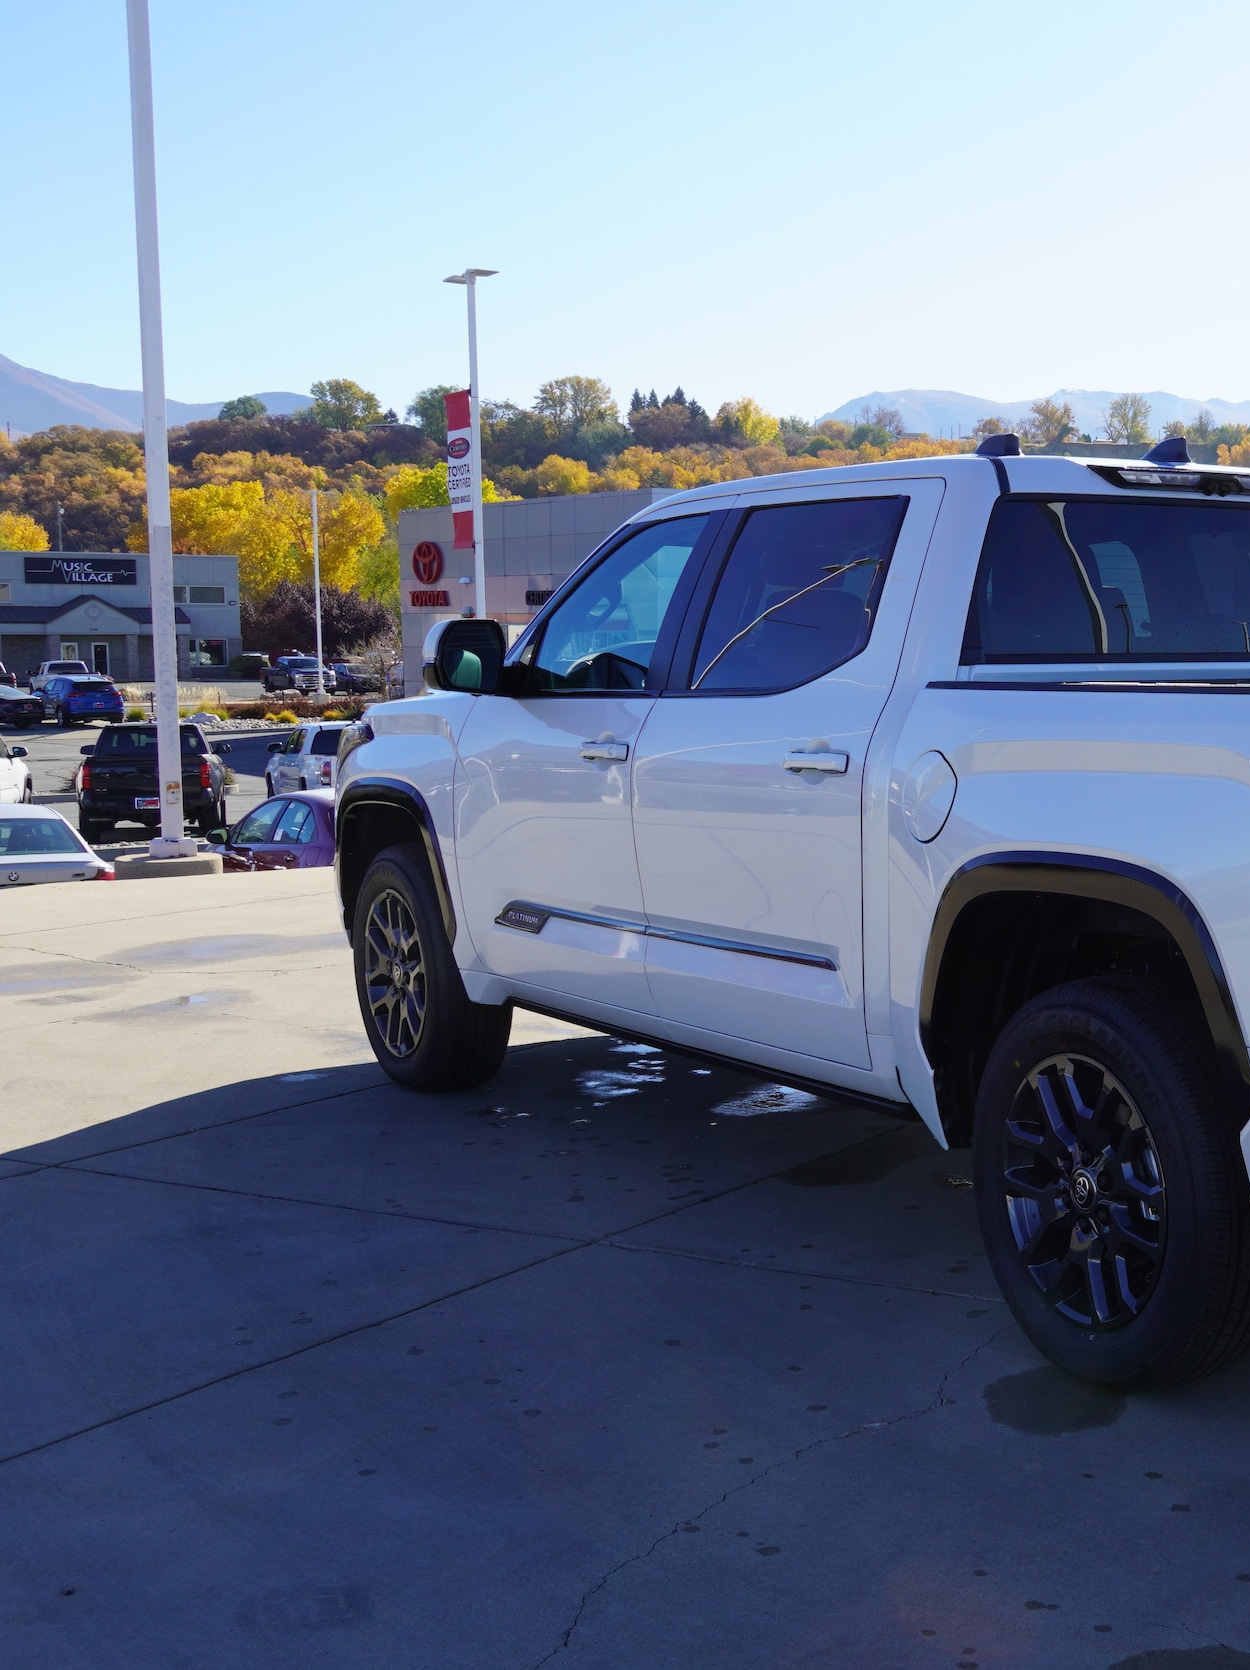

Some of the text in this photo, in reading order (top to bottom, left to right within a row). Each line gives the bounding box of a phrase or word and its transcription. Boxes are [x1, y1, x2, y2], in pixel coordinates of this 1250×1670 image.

[448, 464, 471, 478] TOYOTA
[448, 477, 471, 490] CERTIFIED
[52, 560, 93, 572] MUSIC
[62, 571, 113, 583] VILLAGE
[409, 590, 449, 606] TOYOTA
[508, 910, 539, 925] PLATINUM
[1044, 1013, 1161, 1109] GEOLANDAR
